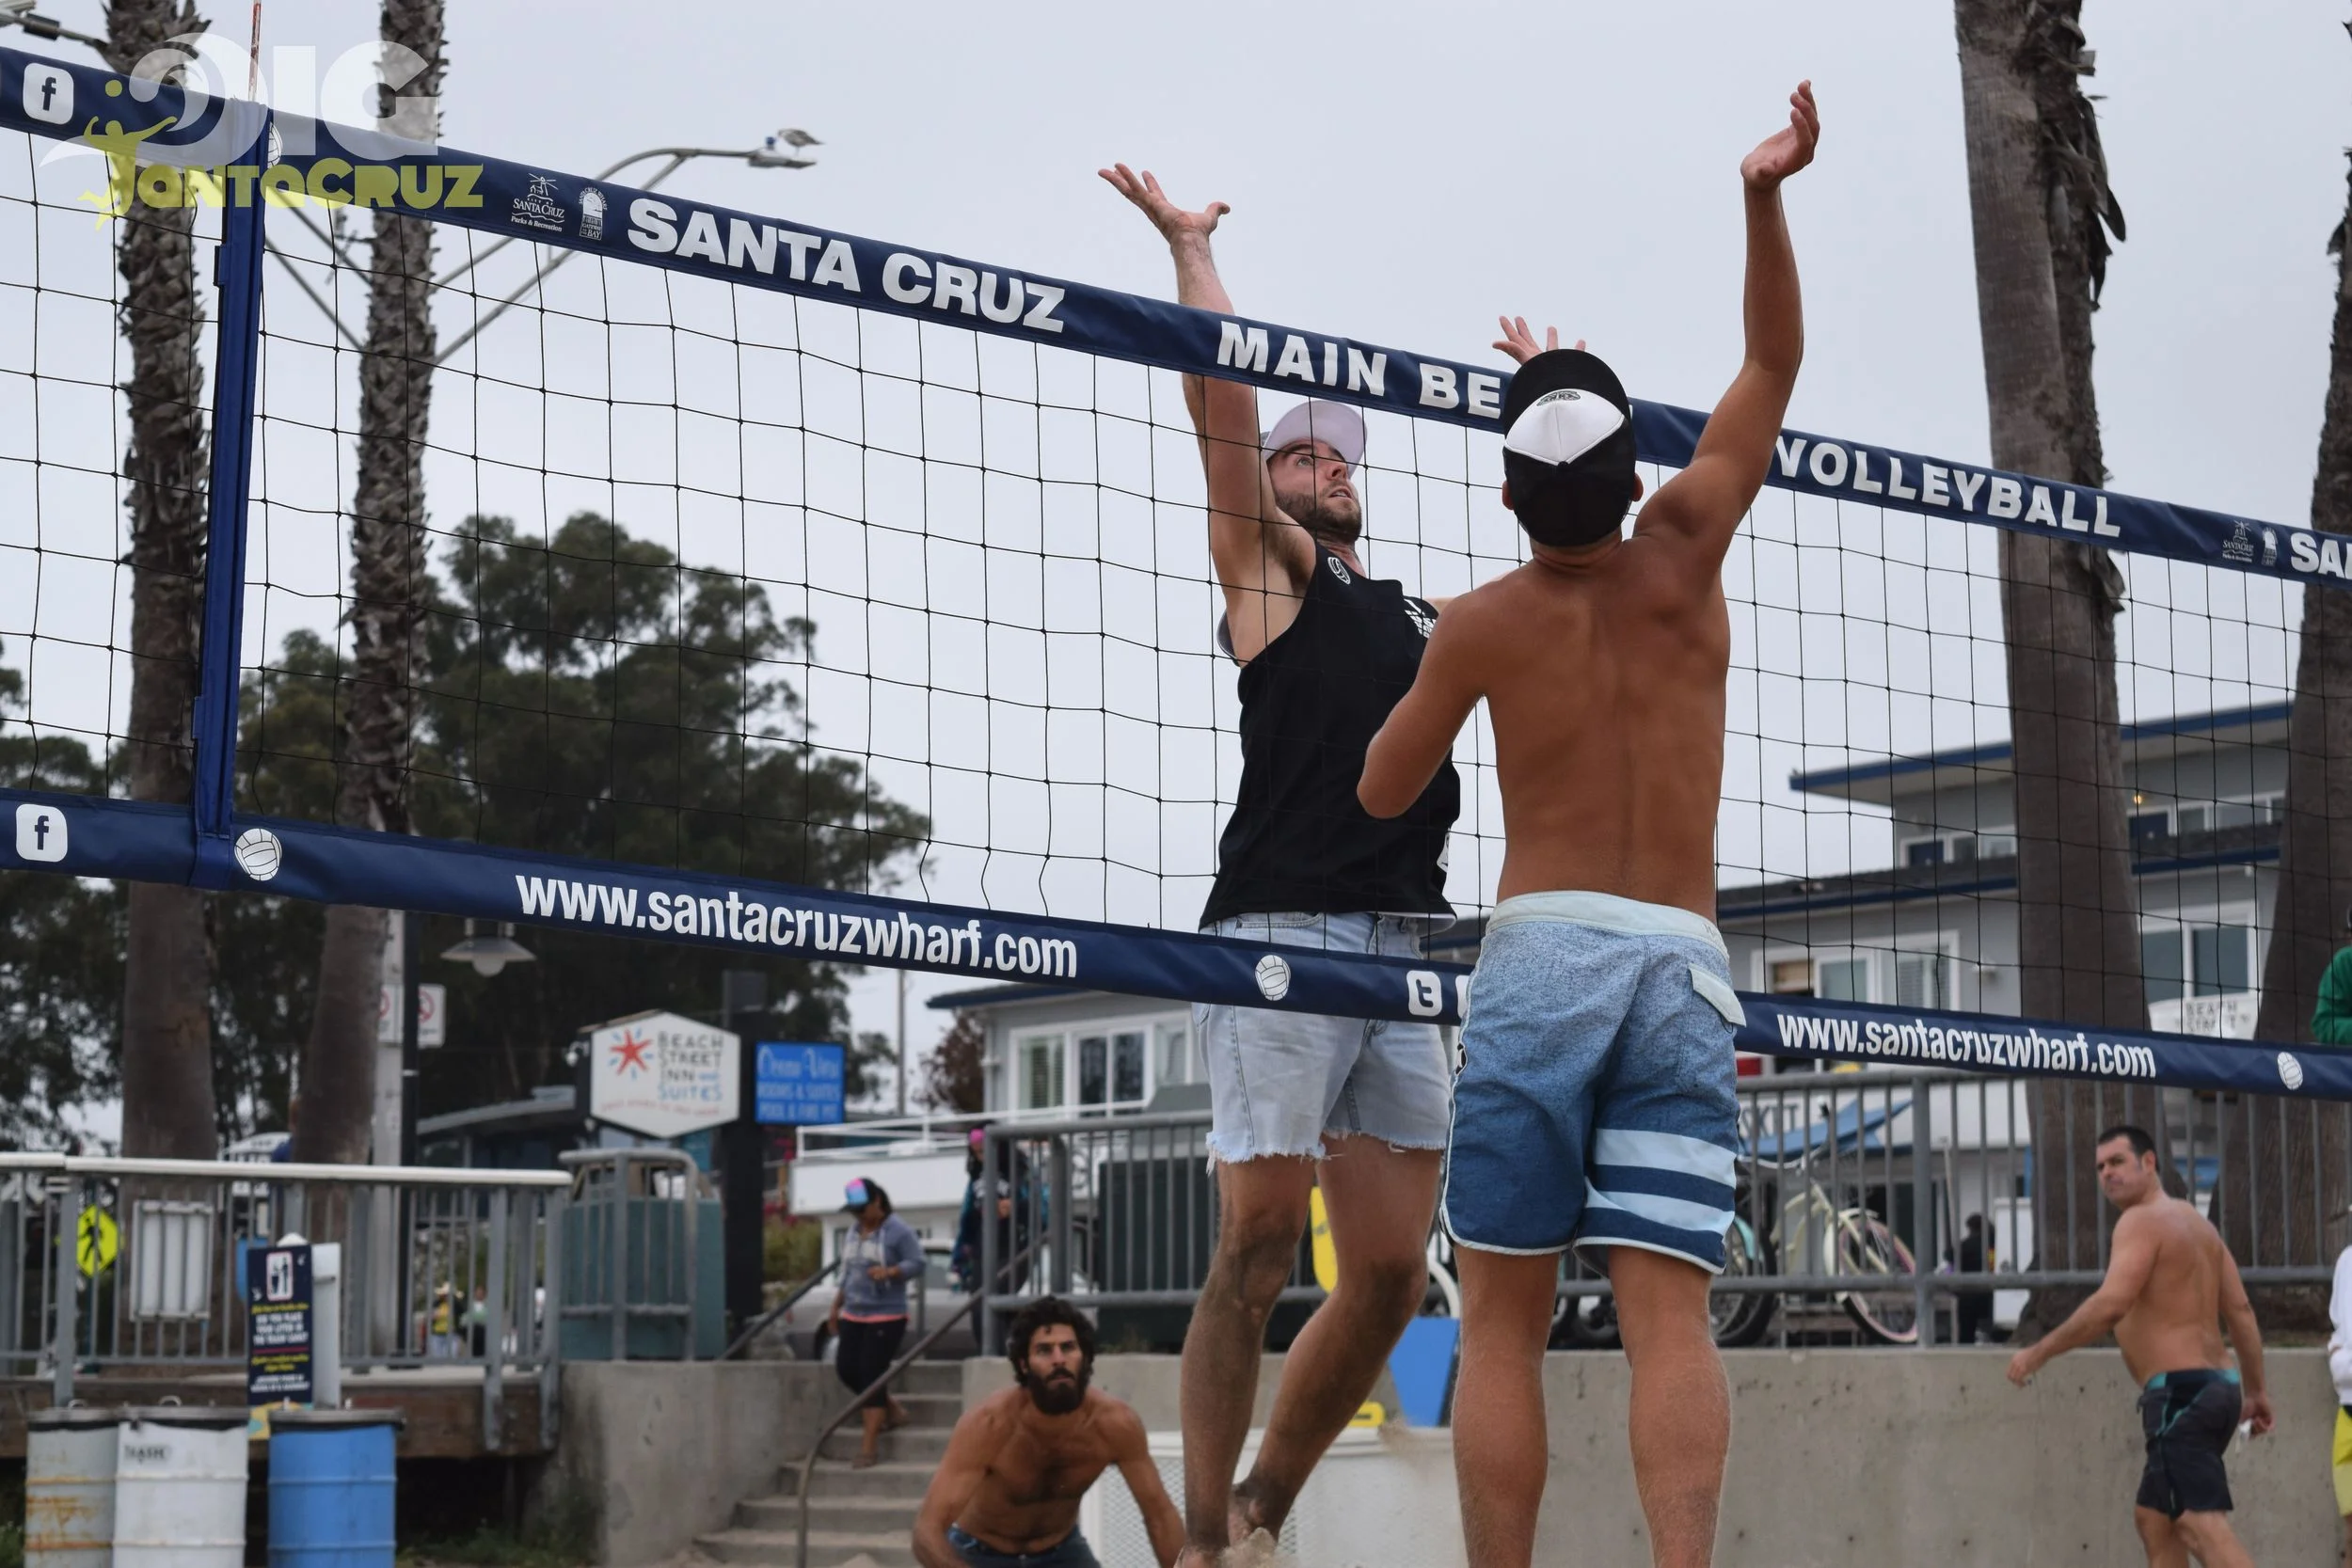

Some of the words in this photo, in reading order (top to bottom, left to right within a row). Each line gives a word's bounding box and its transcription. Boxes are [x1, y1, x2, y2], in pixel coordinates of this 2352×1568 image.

[513, 198, 542, 214] SANTA
[541, 203, 565, 219] CRUZ
[511, 215, 528, 226] Parks
[533, 221, 563, 232] Recreation
[587, 229, 601, 239] BAY
[628, 198, 861, 292] SANTA
[882, 252, 1065, 333] CRUZ
[1216, 321, 1387, 397] MAIN
[1775, 435, 2121, 537] VOLLEYBALL
[2290, 531, 2352, 580] SA
[516, 875, 1078, 978] www.santacruzwharf.com
[659, 1031, 723, 1049] BEACH
[1777, 1013, 2156, 1079] www.santacruzwharf.com
[660, 1050, 723, 1068] STREET
[660, 1067, 696, 1082] INN
[659, 1084, 723, 1101] SUITES
